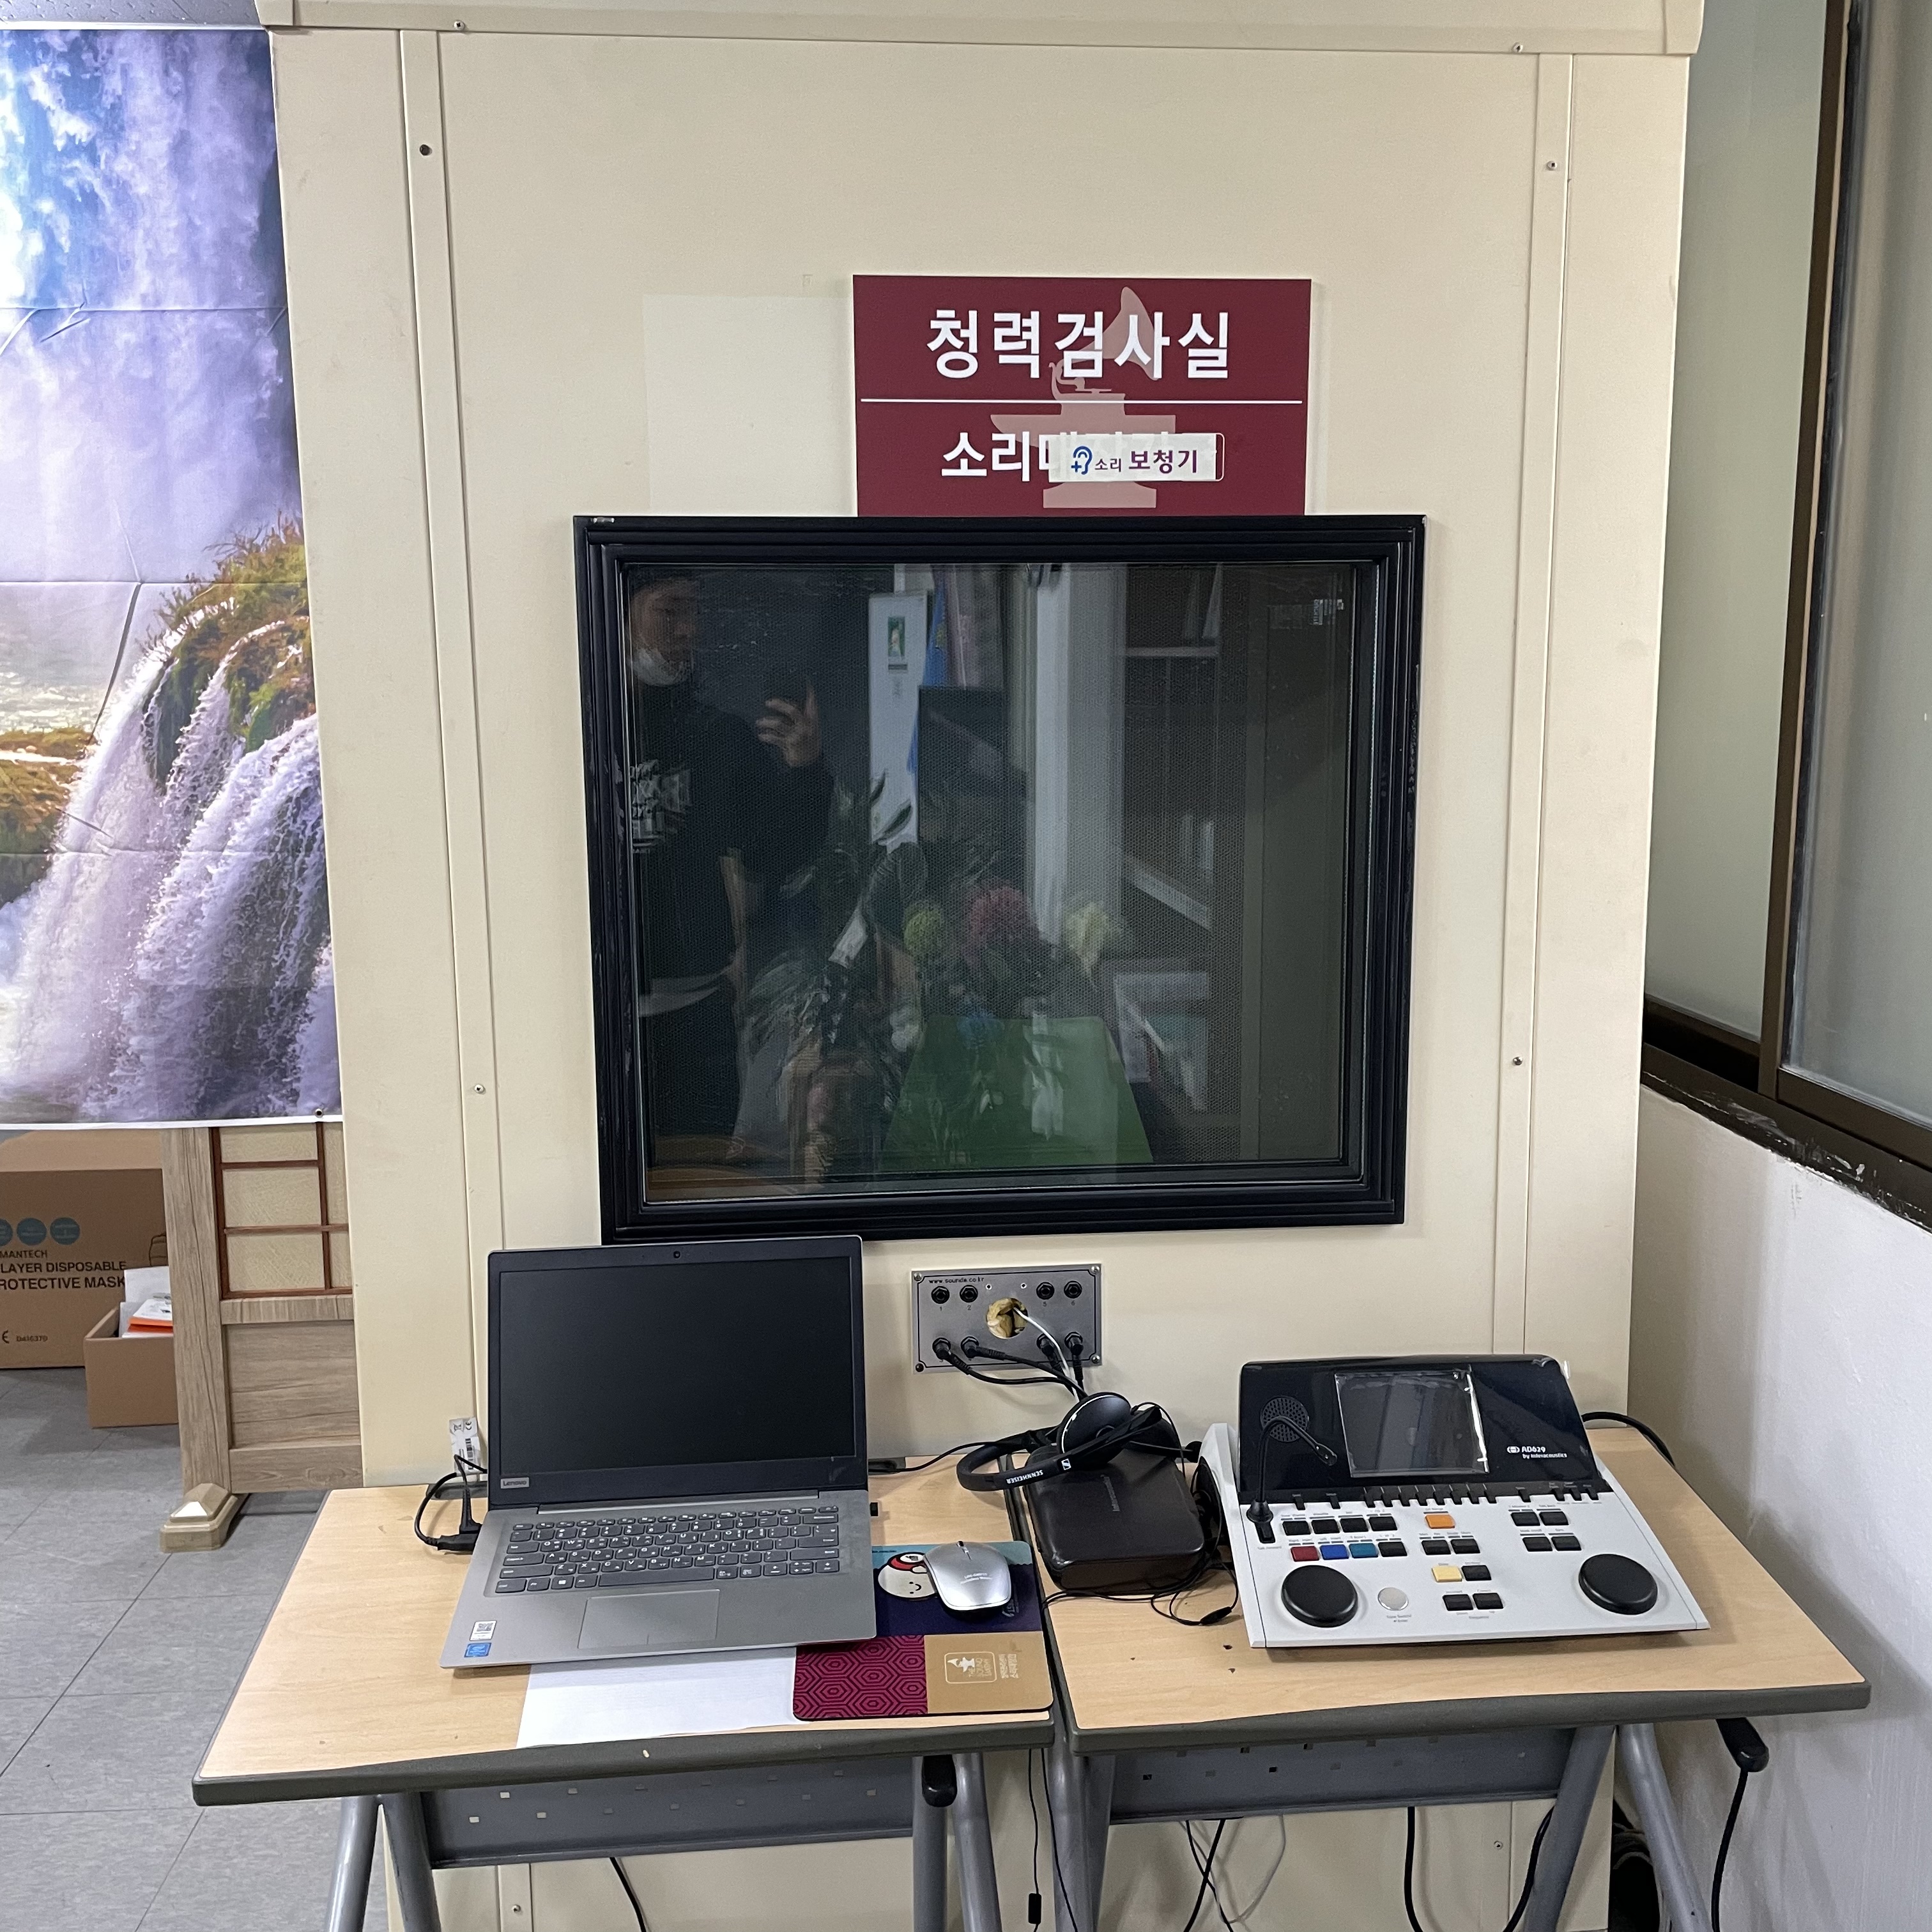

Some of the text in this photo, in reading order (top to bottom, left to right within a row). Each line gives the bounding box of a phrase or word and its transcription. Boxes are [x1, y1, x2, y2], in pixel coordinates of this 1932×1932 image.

[926, 309, 1229, 380] 청력검사실
[1094, 449, 1197, 474] 소리 보청기
[1, 1261, 127, 1274] LAYER DISPOSABLE
[84, 1276, 125, 1289] MASK
[1006, 1469, 1044, 1484] SENNHEISER
